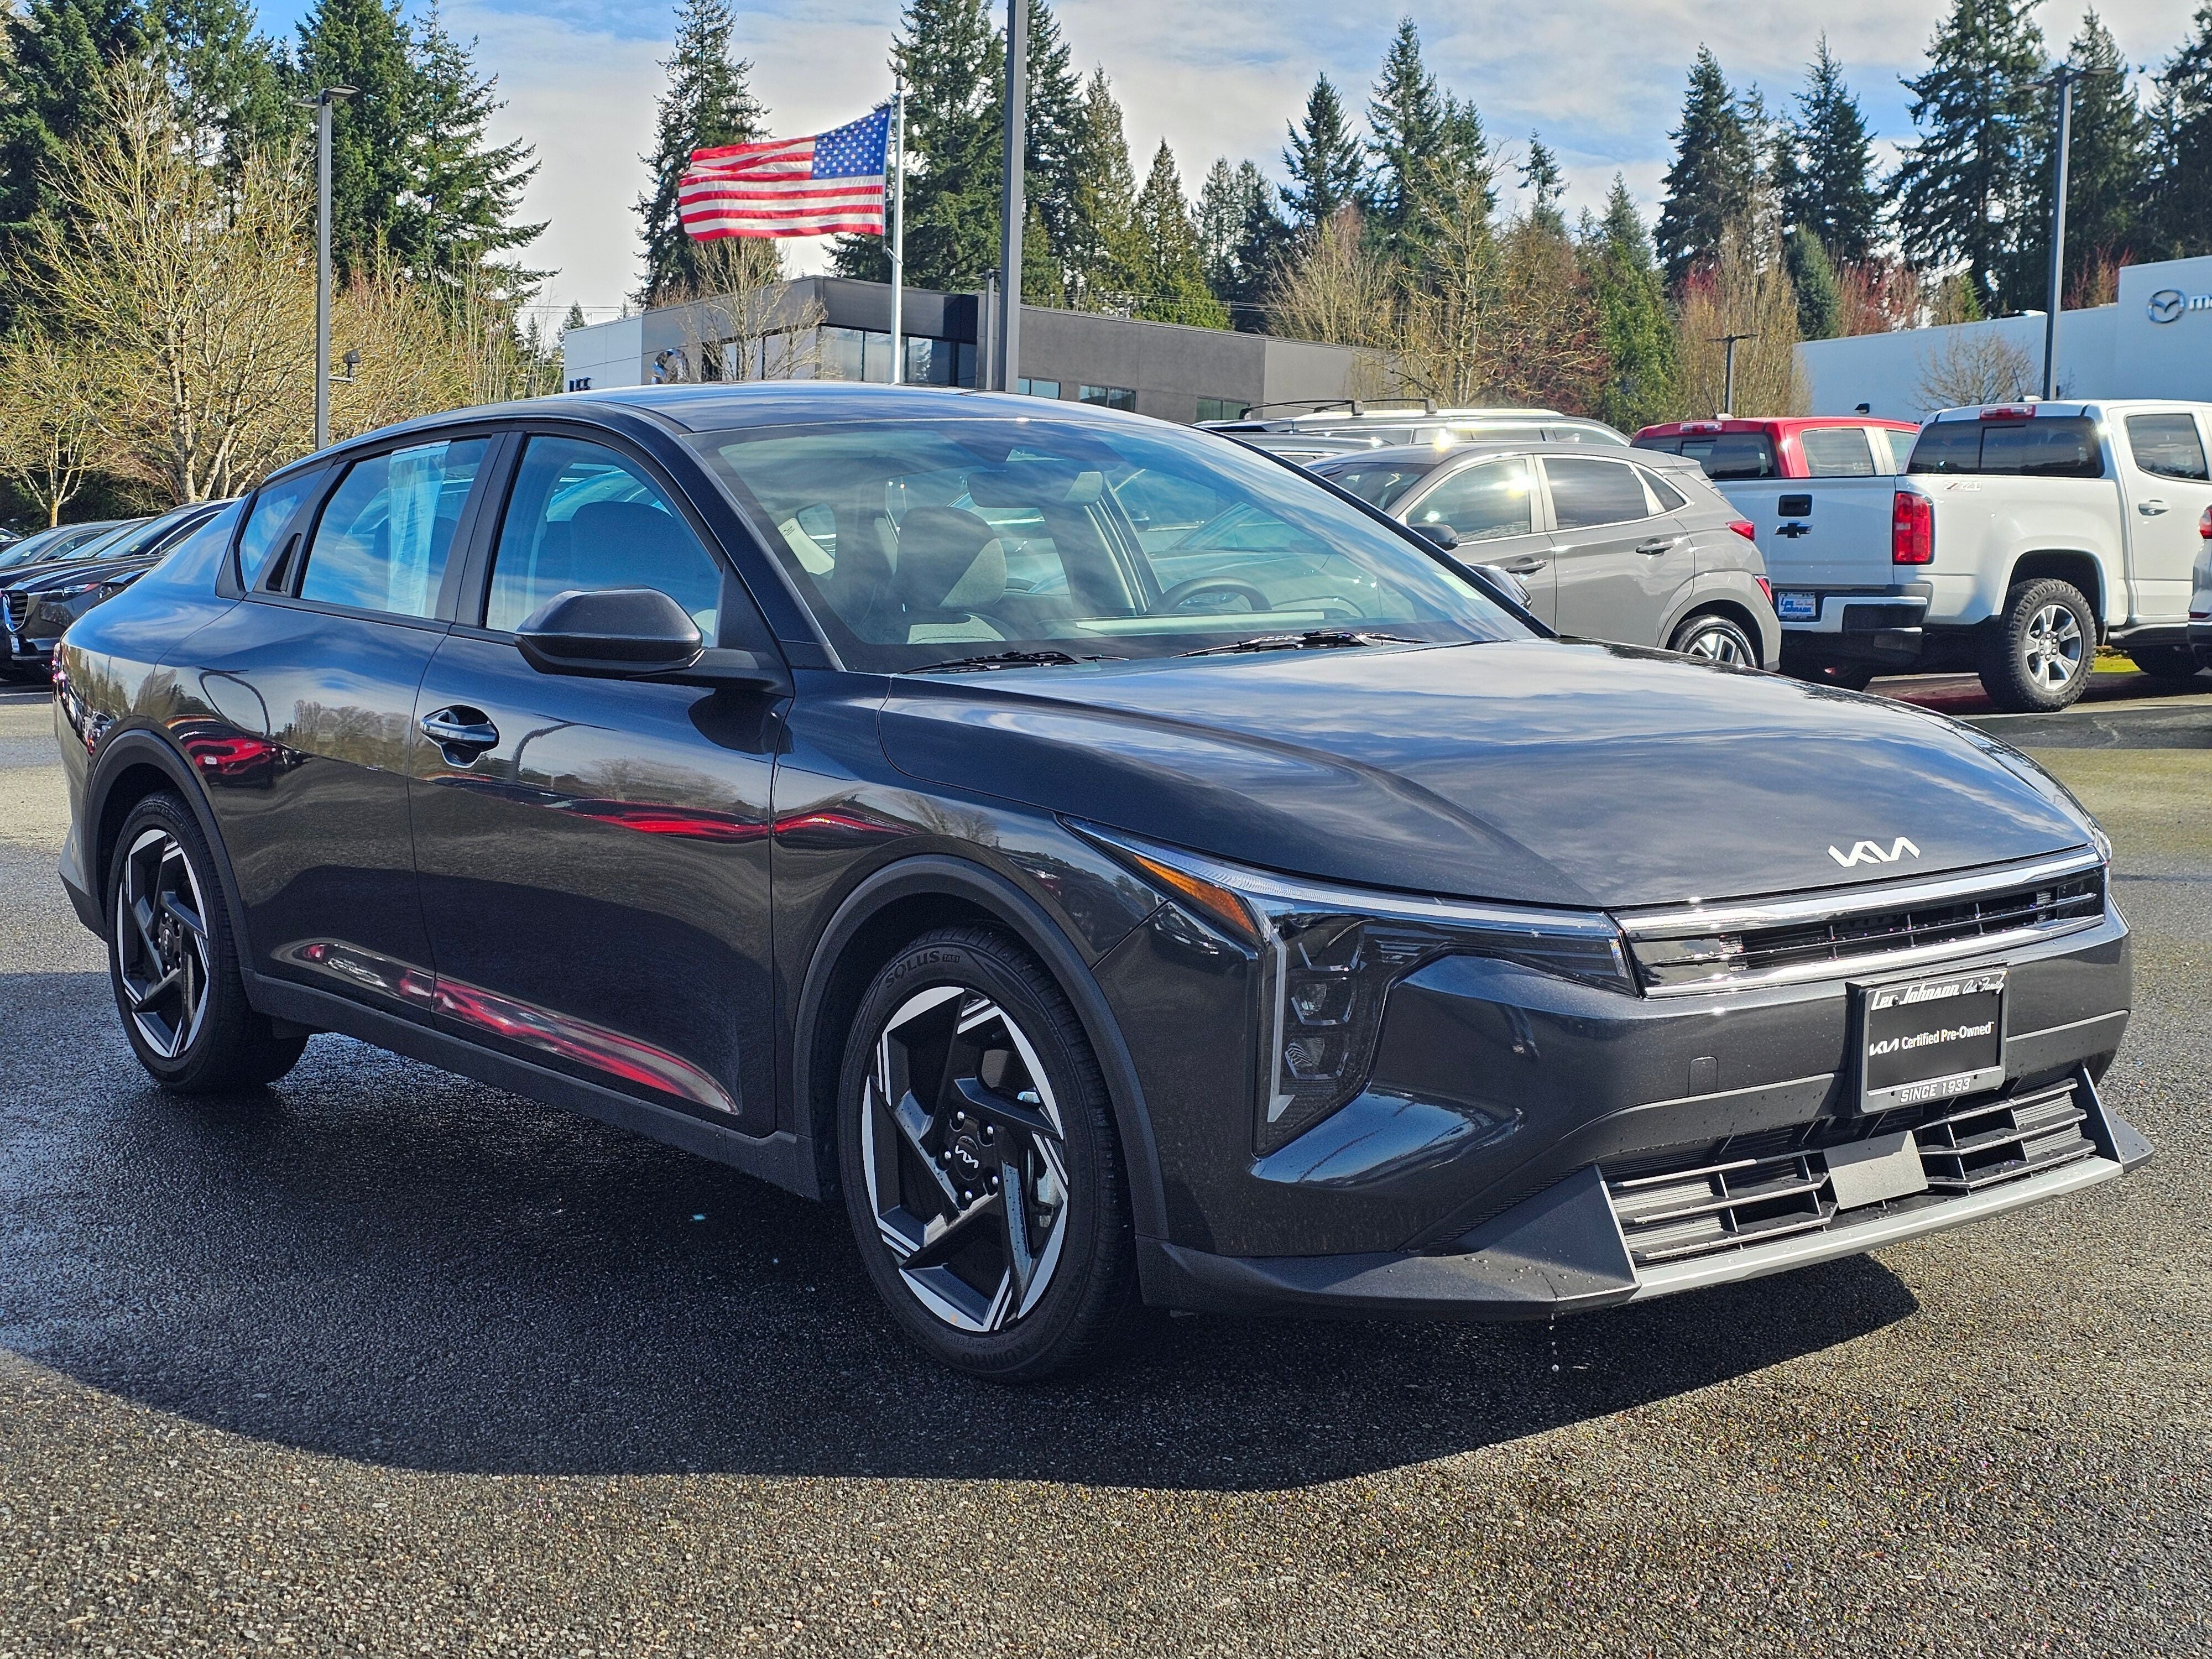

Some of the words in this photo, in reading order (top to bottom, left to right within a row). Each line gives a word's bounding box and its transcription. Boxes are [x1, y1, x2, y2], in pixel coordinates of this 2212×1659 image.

[2188, 294, 2212, 310] m
[1827, 836, 1921, 868] KIA
[885, 950, 940, 988] SOLUS
[1898, 982, 1960, 1005] Johnson
[1869, 1037, 1900, 1056] KIA
[1901, 1030, 1940, 1050] Certified
[1900, 1083, 1938, 1103] SINCE
[1942, 1078, 1971, 1095] 1933
